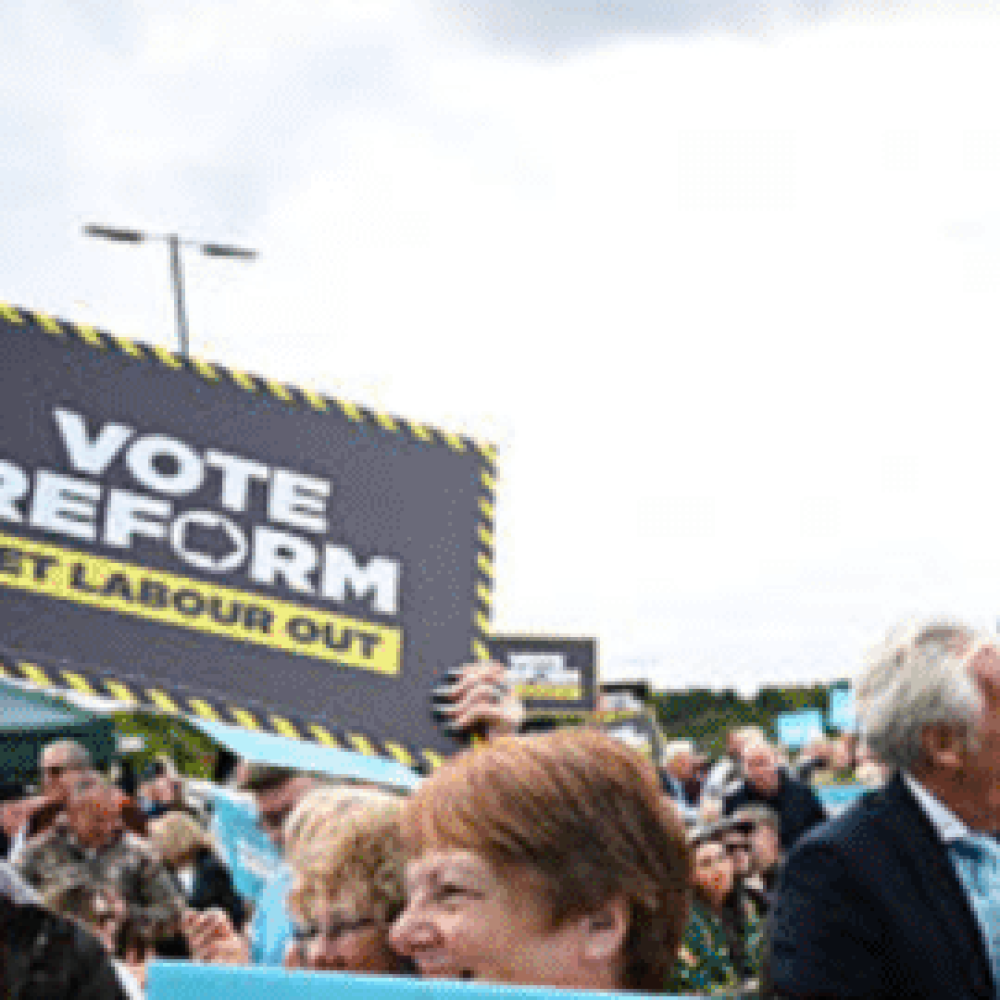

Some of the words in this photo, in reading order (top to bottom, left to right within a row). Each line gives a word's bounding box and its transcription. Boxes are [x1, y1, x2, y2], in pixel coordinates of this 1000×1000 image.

[53, 407, 332, 533] VOTE
[0, 546, 57, 582] ET
[71, 561, 274, 634] LABOUR
[286, 614, 381, 659] OUT
